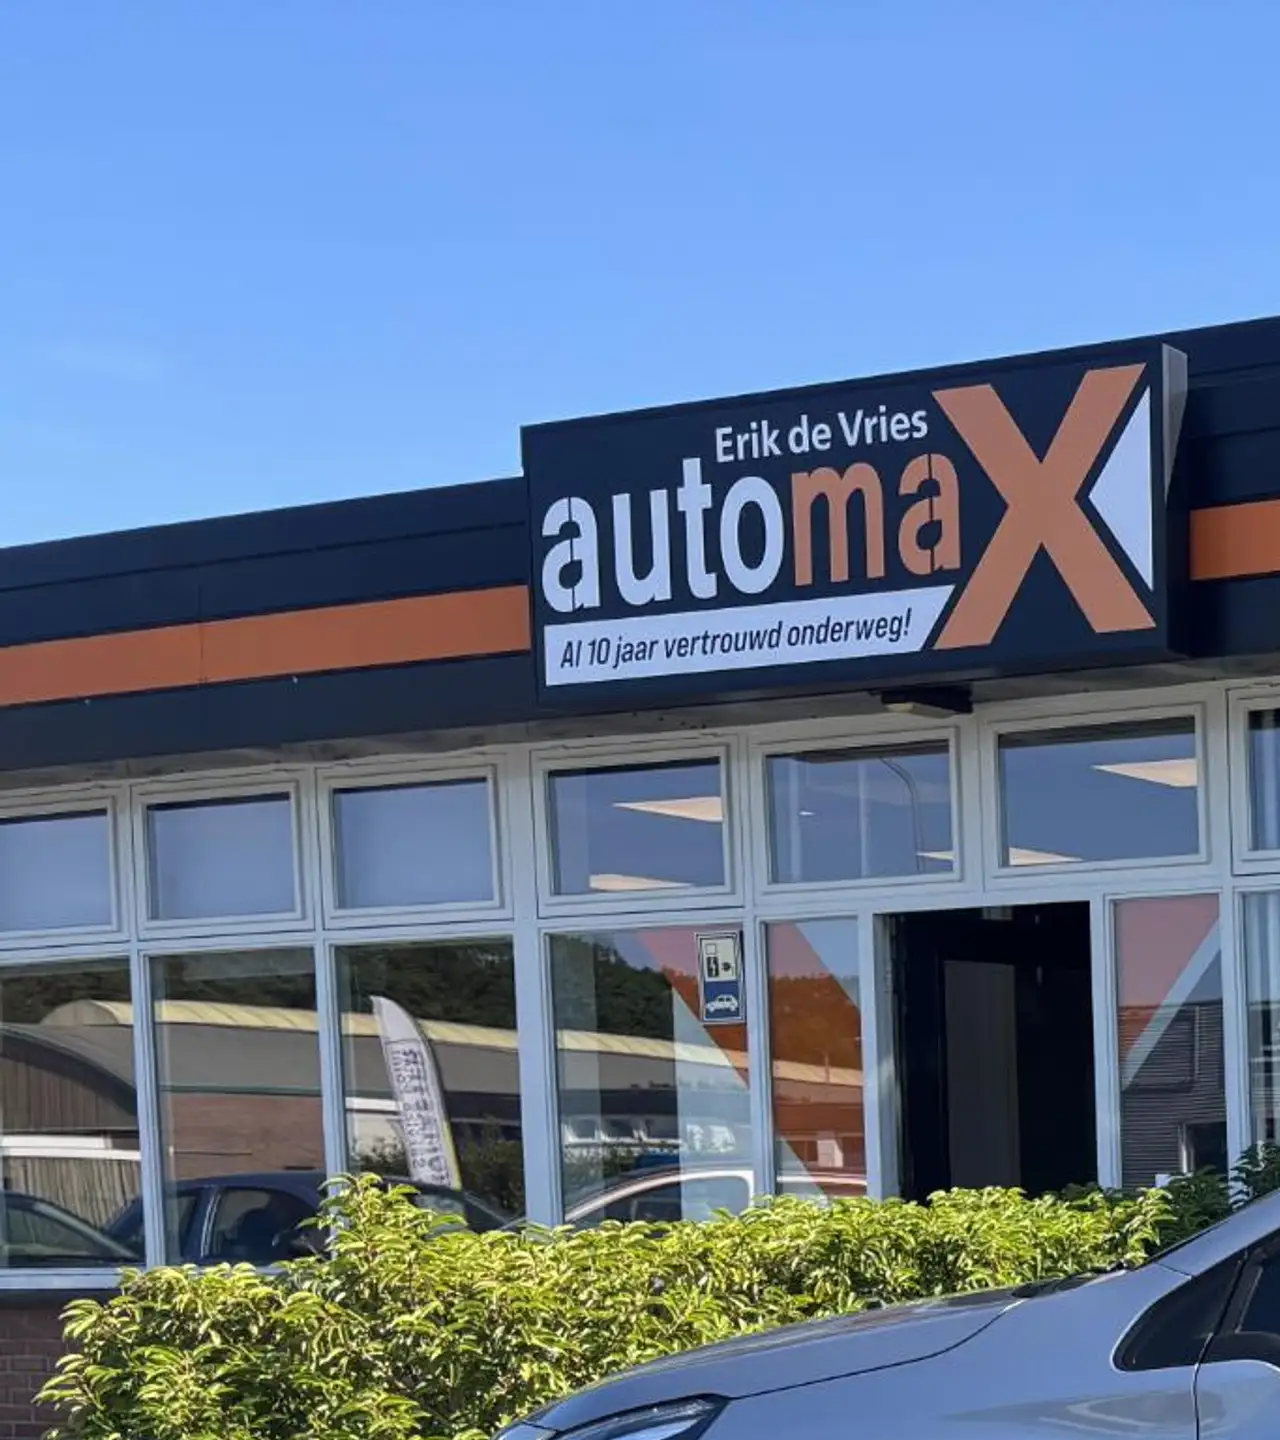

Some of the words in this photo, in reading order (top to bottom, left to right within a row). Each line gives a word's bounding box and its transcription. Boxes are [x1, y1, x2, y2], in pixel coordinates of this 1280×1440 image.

[716, 420, 783, 462] Erik
[788, 414, 832, 453] de
[837, 405, 929, 447] Vries
[542, 363, 1157, 650] automaX
[560, 640, 582, 669] Al
[587, 637, 611, 666] 10
[612, 635, 659, 669] jaar
[663, 620, 783, 660] vertrouwd
[787, 607, 912, 647] onderweg!
